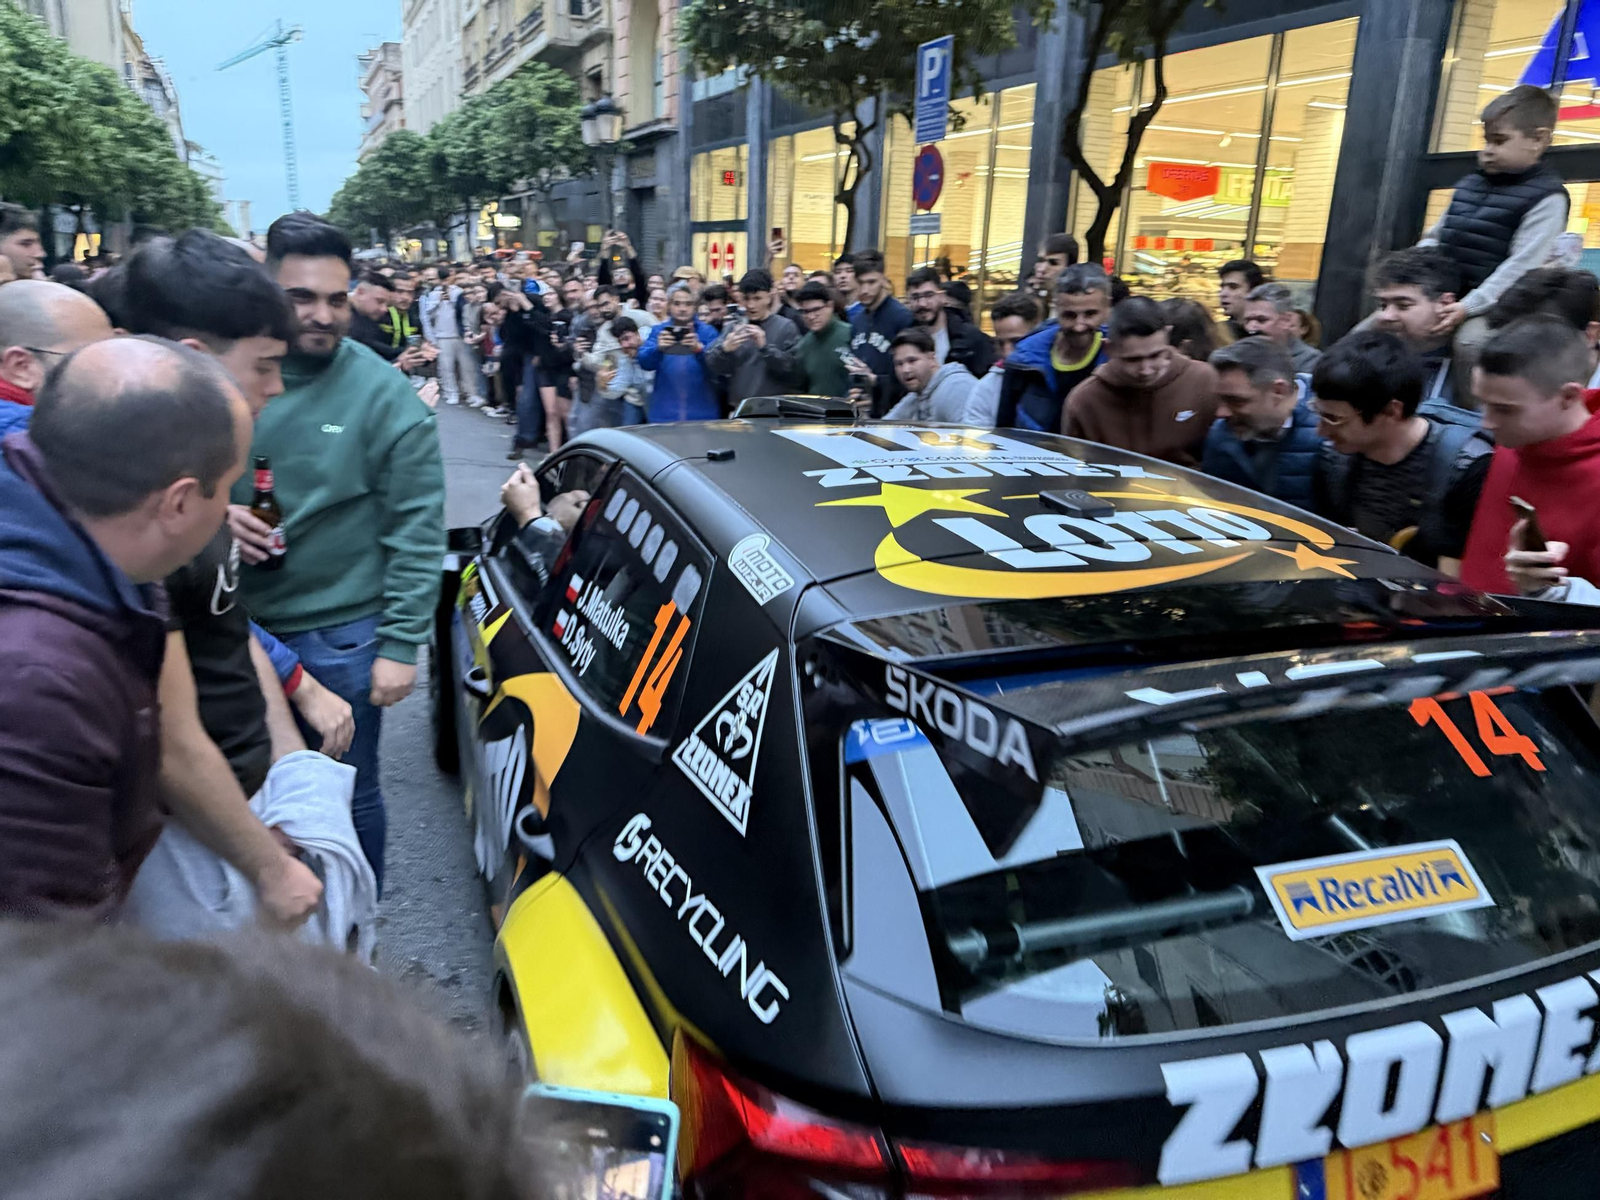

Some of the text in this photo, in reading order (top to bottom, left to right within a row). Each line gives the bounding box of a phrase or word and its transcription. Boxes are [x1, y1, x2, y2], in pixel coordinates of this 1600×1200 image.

[921, 46, 942, 98] P
[932, 508, 1271, 568] LOTTO
[561, 613, 597, 677] D.Syty
[577, 580, 630, 651] J.Matulka
[618, 599, 691, 736] 14
[1408, 686, 1547, 778] 14
[1316, 861, 1441, 914] Recalvi
